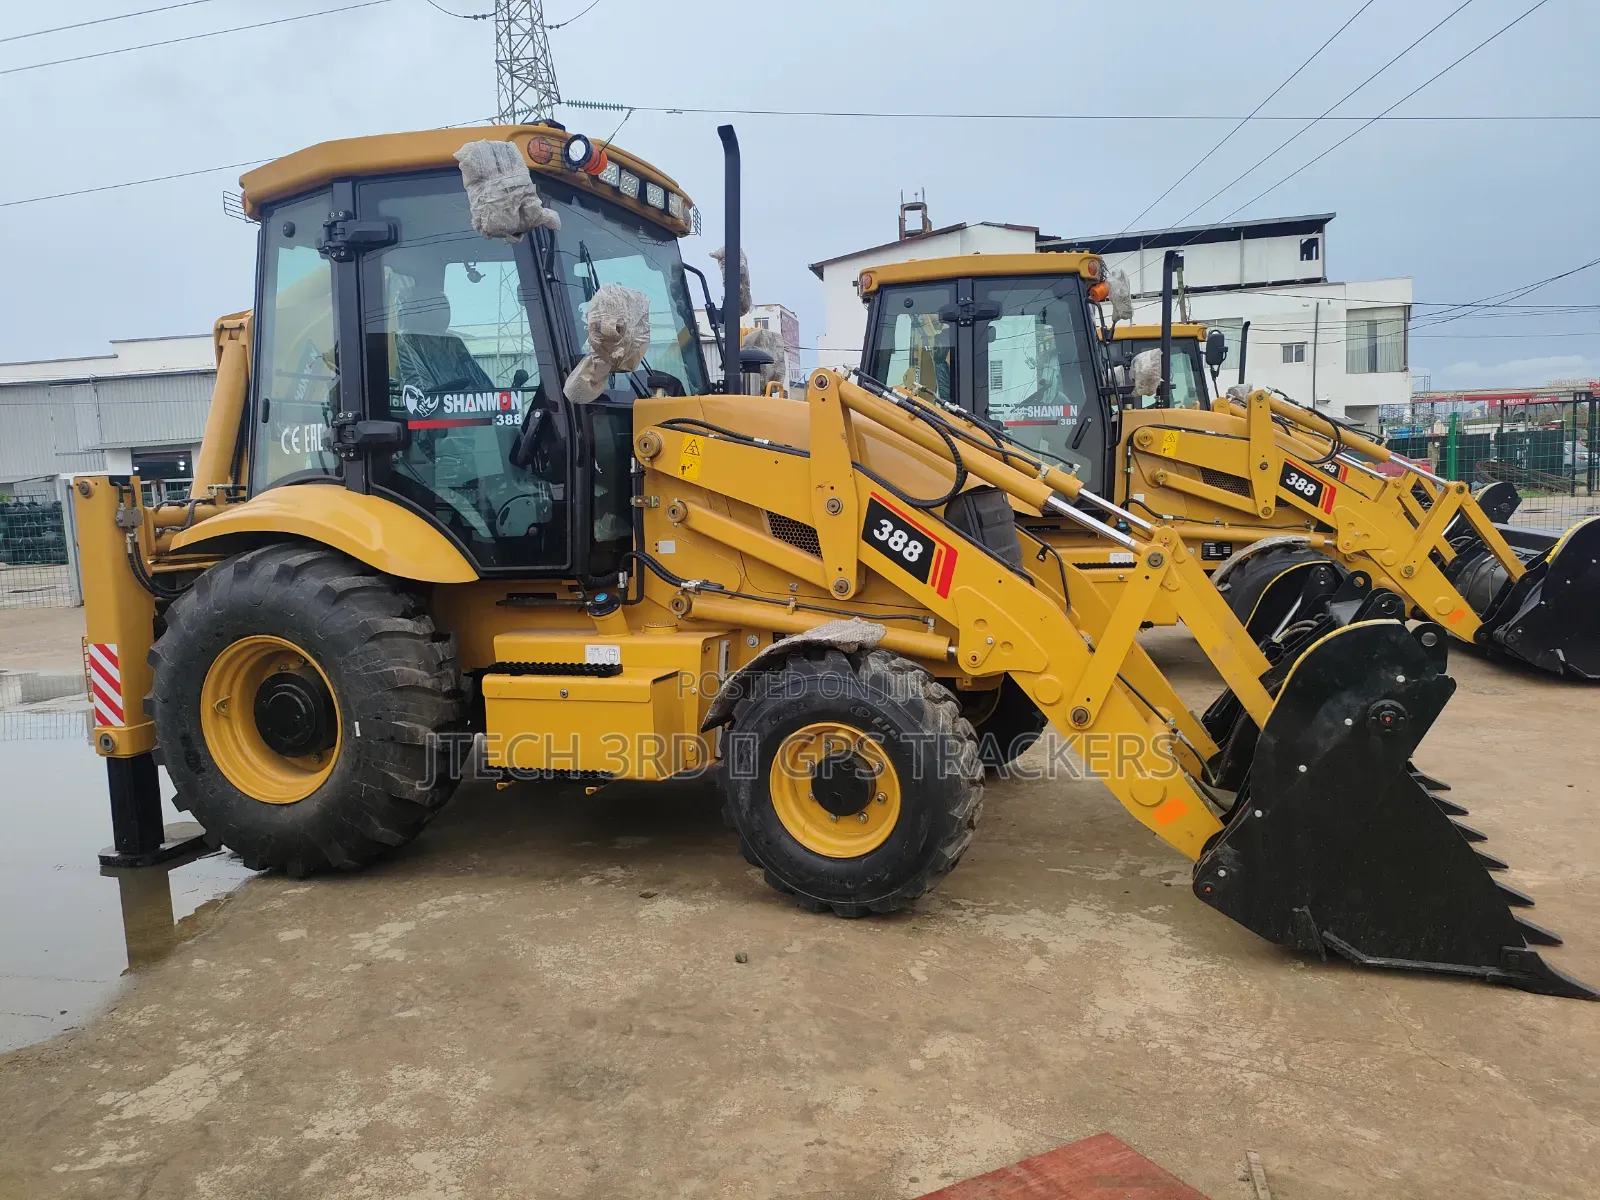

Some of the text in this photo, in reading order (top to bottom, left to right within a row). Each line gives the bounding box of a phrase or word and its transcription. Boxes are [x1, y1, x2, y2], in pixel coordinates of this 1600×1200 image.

[443, 390, 522, 414] SHANMON
[1027, 404, 1078, 417] SHANMON
[495, 414, 522, 426] 388
[1060, 418, 1077, 426] 388
[1286, 472, 1316, 496] 388
[873, 519, 924, 562] 388
